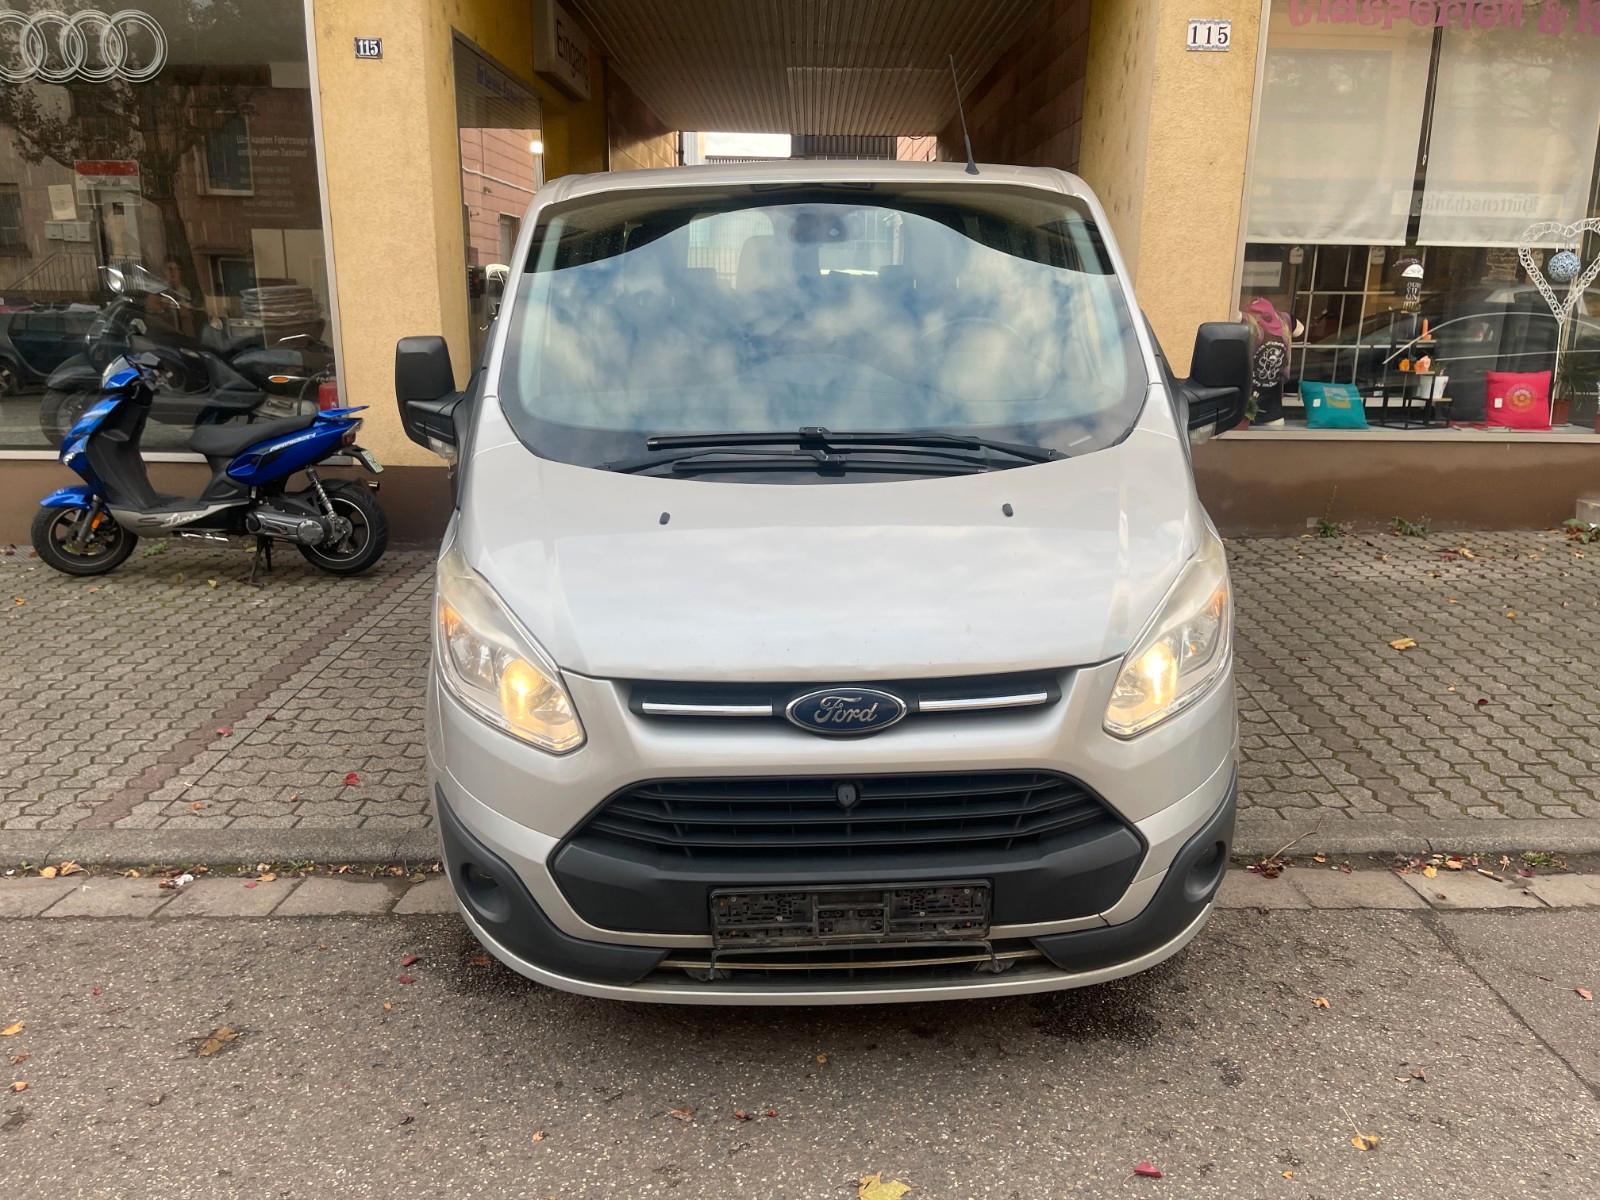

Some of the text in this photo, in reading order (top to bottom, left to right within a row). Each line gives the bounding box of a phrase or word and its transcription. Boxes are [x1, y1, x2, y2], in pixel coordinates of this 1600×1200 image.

[1190, 25, 1229, 45] 115
[358, 39, 379, 56] 115
[814, 696, 879, 724] Ford
